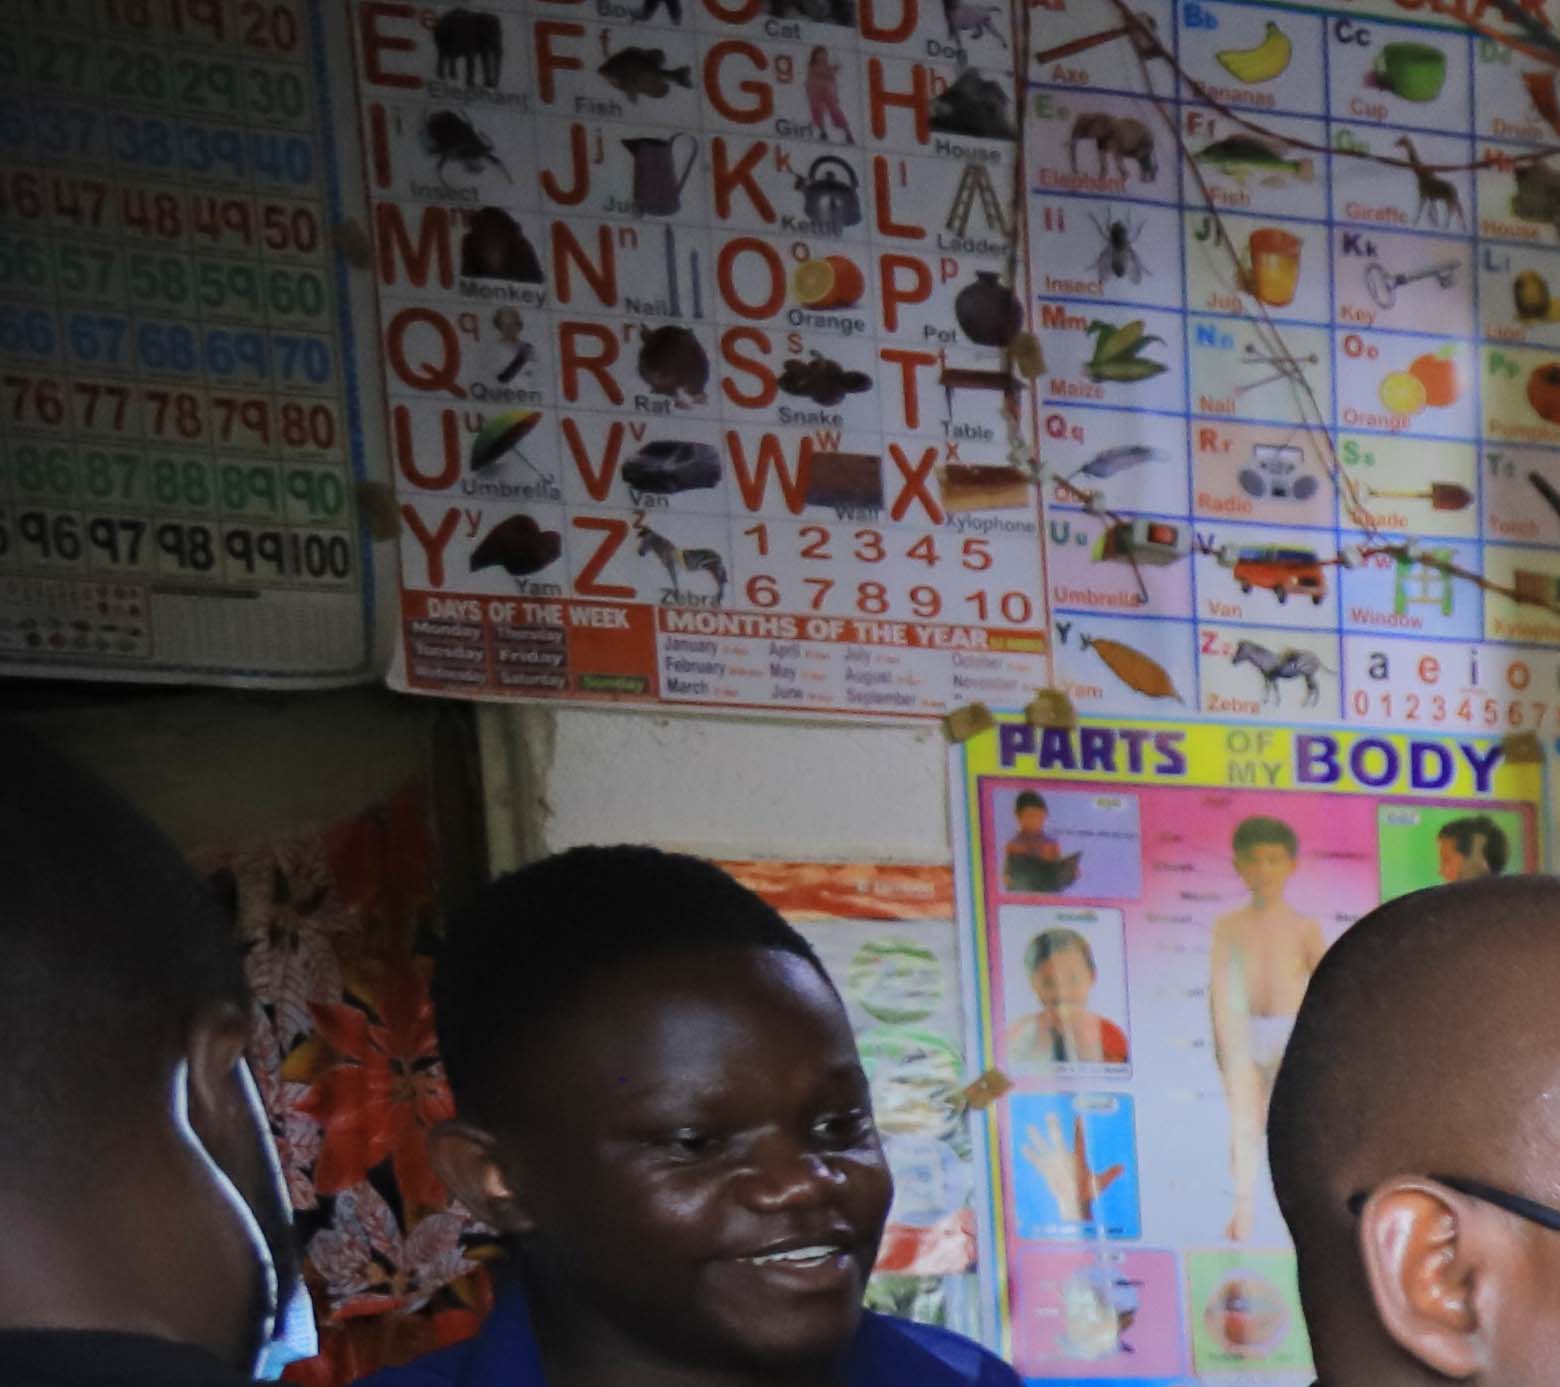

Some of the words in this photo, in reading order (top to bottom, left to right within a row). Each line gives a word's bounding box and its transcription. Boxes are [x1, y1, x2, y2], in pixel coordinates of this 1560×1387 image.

[245, 3, 297, 51] 20
[263, 204, 318, 253] 50
[788, 308, 865, 336] Orange
[280, 402, 335, 449] 80
[777, 406, 844, 426] Snake
[941, 420, 995, 440] Table
[461, 473, 561, 501] Umbrella
[21, 513, 80, 559] 96
[89, 518, 145, 564] 97
[158, 523, 214, 570] 98
[225, 529, 283, 574] 99
[290, 532, 351, 578] 100
[426, 598, 482, 620] DAYS
[488, 601, 517, 622] OF
[522, 603, 564, 625] THE
[570, 607, 632, 630] WEEK
[665, 609, 797, 637] MONTHS
[806, 618, 840, 641] OF
[856, 621, 907, 642] THE
[917, 624, 989, 645] YEAR
[999, 722, 1187, 775] PARTS
[1228, 730, 1274, 754] OF
[1228, 763, 1281, 785] MY
[1295, 734, 1506, 793] BODY
